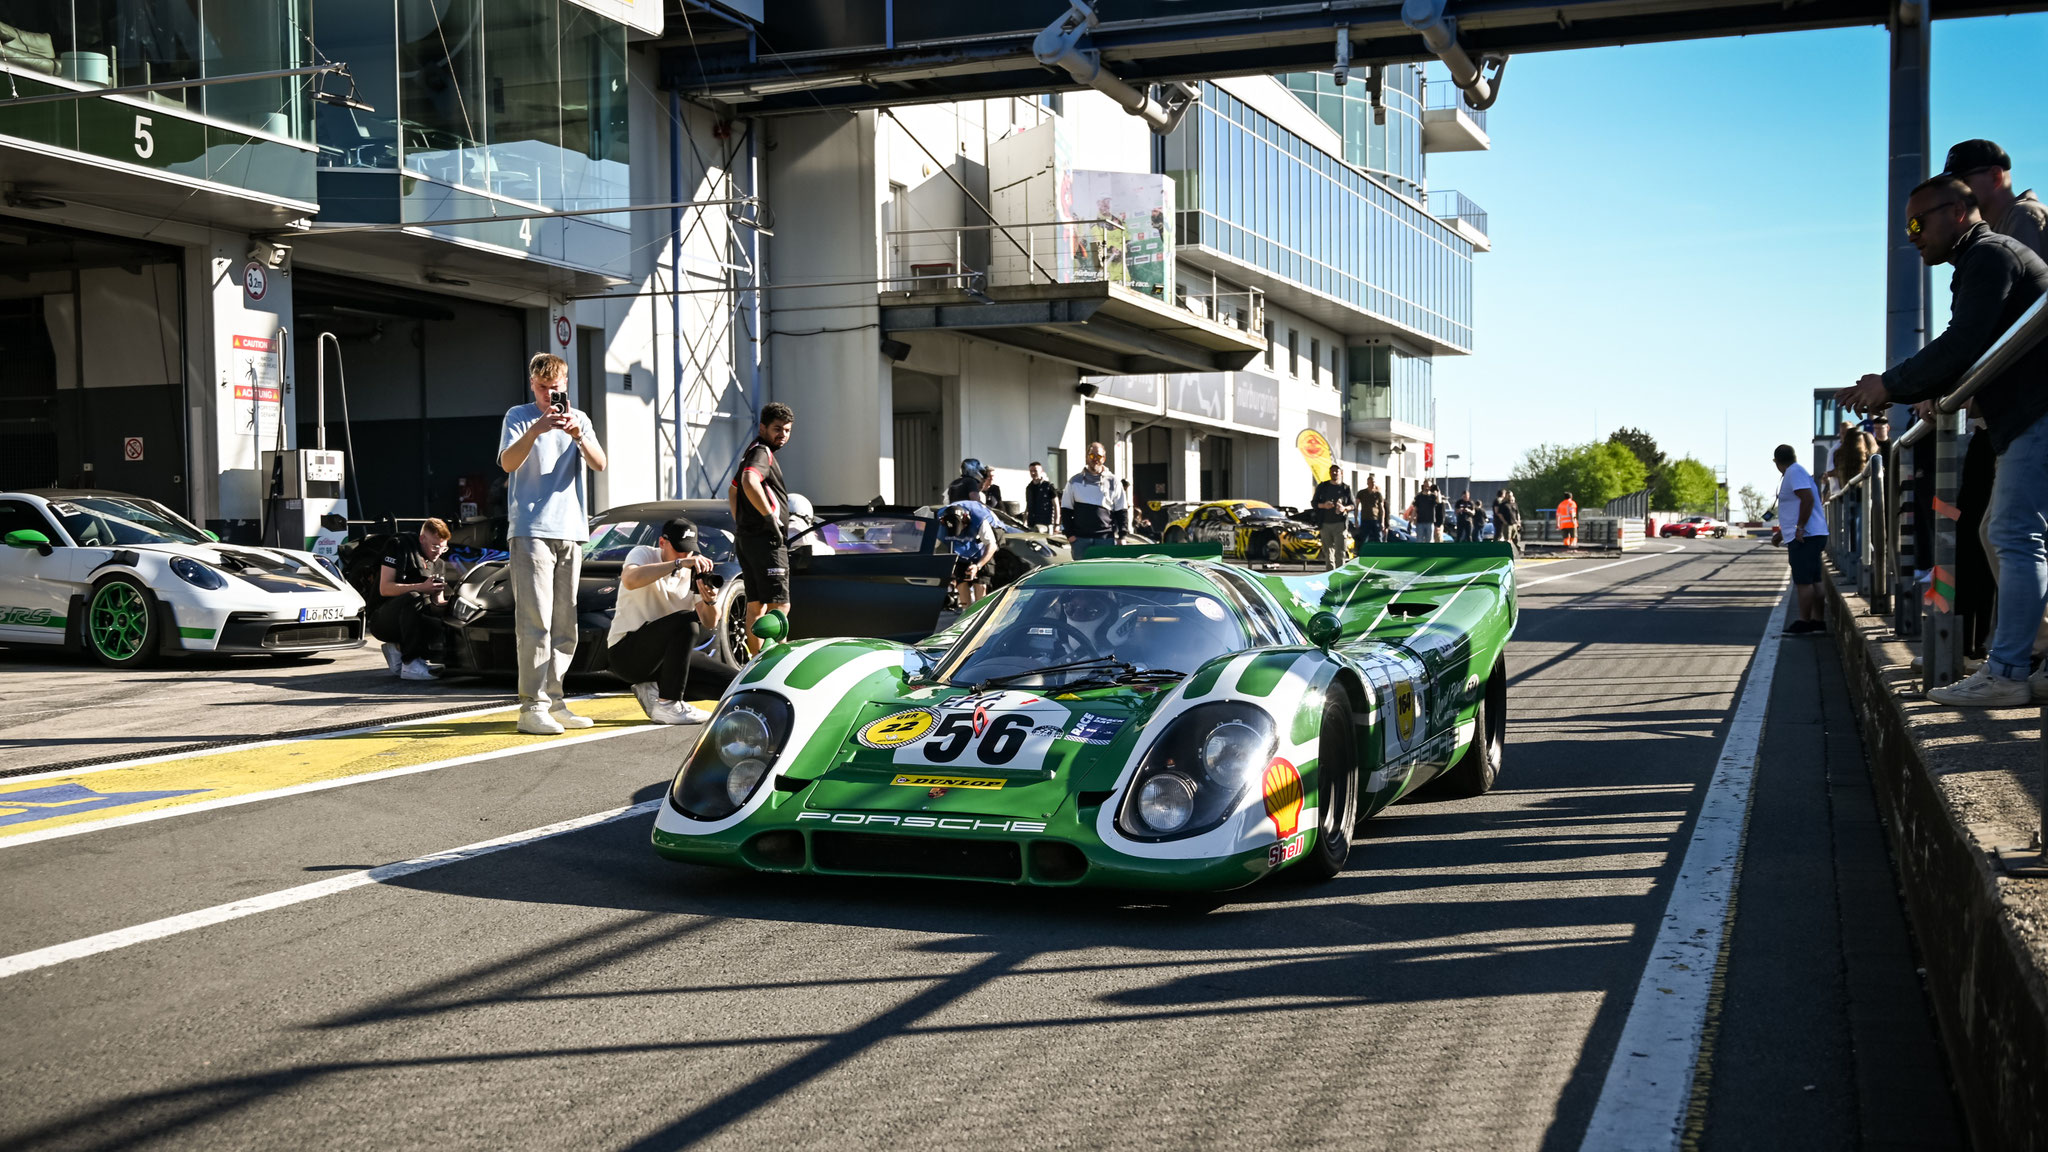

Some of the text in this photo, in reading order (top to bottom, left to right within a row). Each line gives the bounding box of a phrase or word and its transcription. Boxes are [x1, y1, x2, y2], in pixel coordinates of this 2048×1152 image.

[134, 115, 154, 159] 5
[519, 218, 532, 247] 4
[242, 339, 268, 349] CAUTION
[242, 388, 273, 399] ACUNG
[1236, 381, 1278, 421] nürburgring
[0, 606, 52, 625] RS
[305, 608, 344, 621] LÖ RS 14
[896, 712, 919, 721] GER
[1070, 712, 1095, 736] RACE
[878, 721, 919, 734] 22
[923, 713, 1035, 766] 56
[911, 777, 1002, 788] DUNLOP
[796, 812, 1048, 833] PORSCHE
[1268, 834, 1304, 868] Shell
